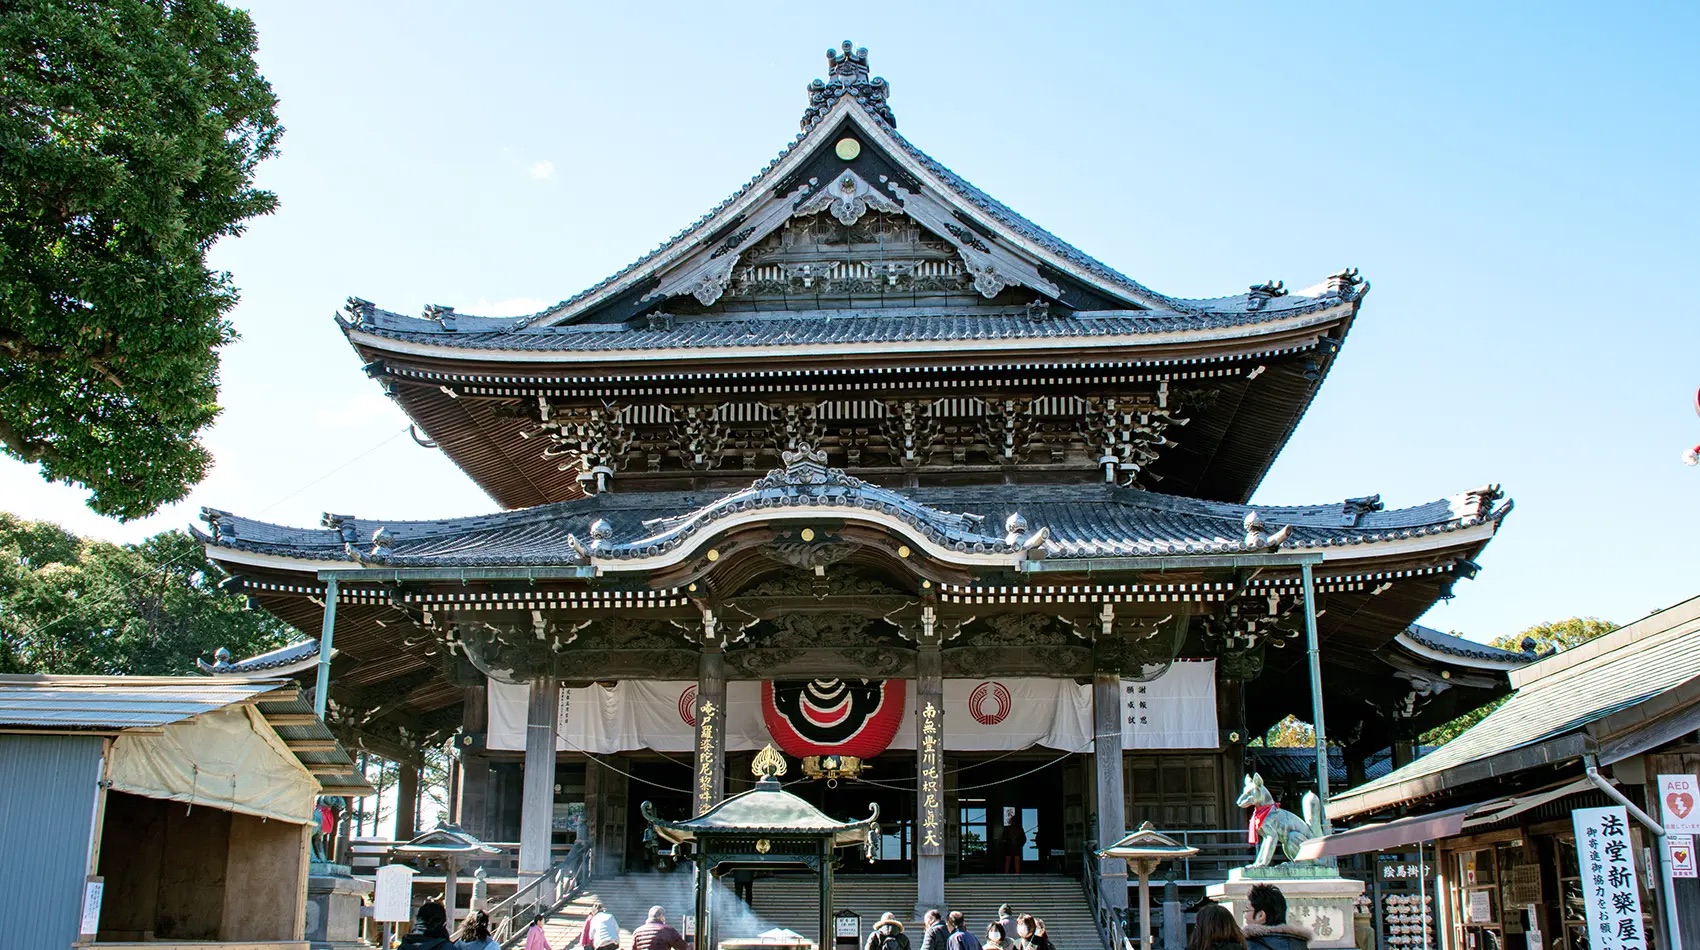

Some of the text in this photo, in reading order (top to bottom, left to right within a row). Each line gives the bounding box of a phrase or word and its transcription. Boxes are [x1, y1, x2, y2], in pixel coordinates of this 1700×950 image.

[1667, 781, 1690, 790] AED
[1586, 827, 1613, 950] 御寄進御協力をお願い
